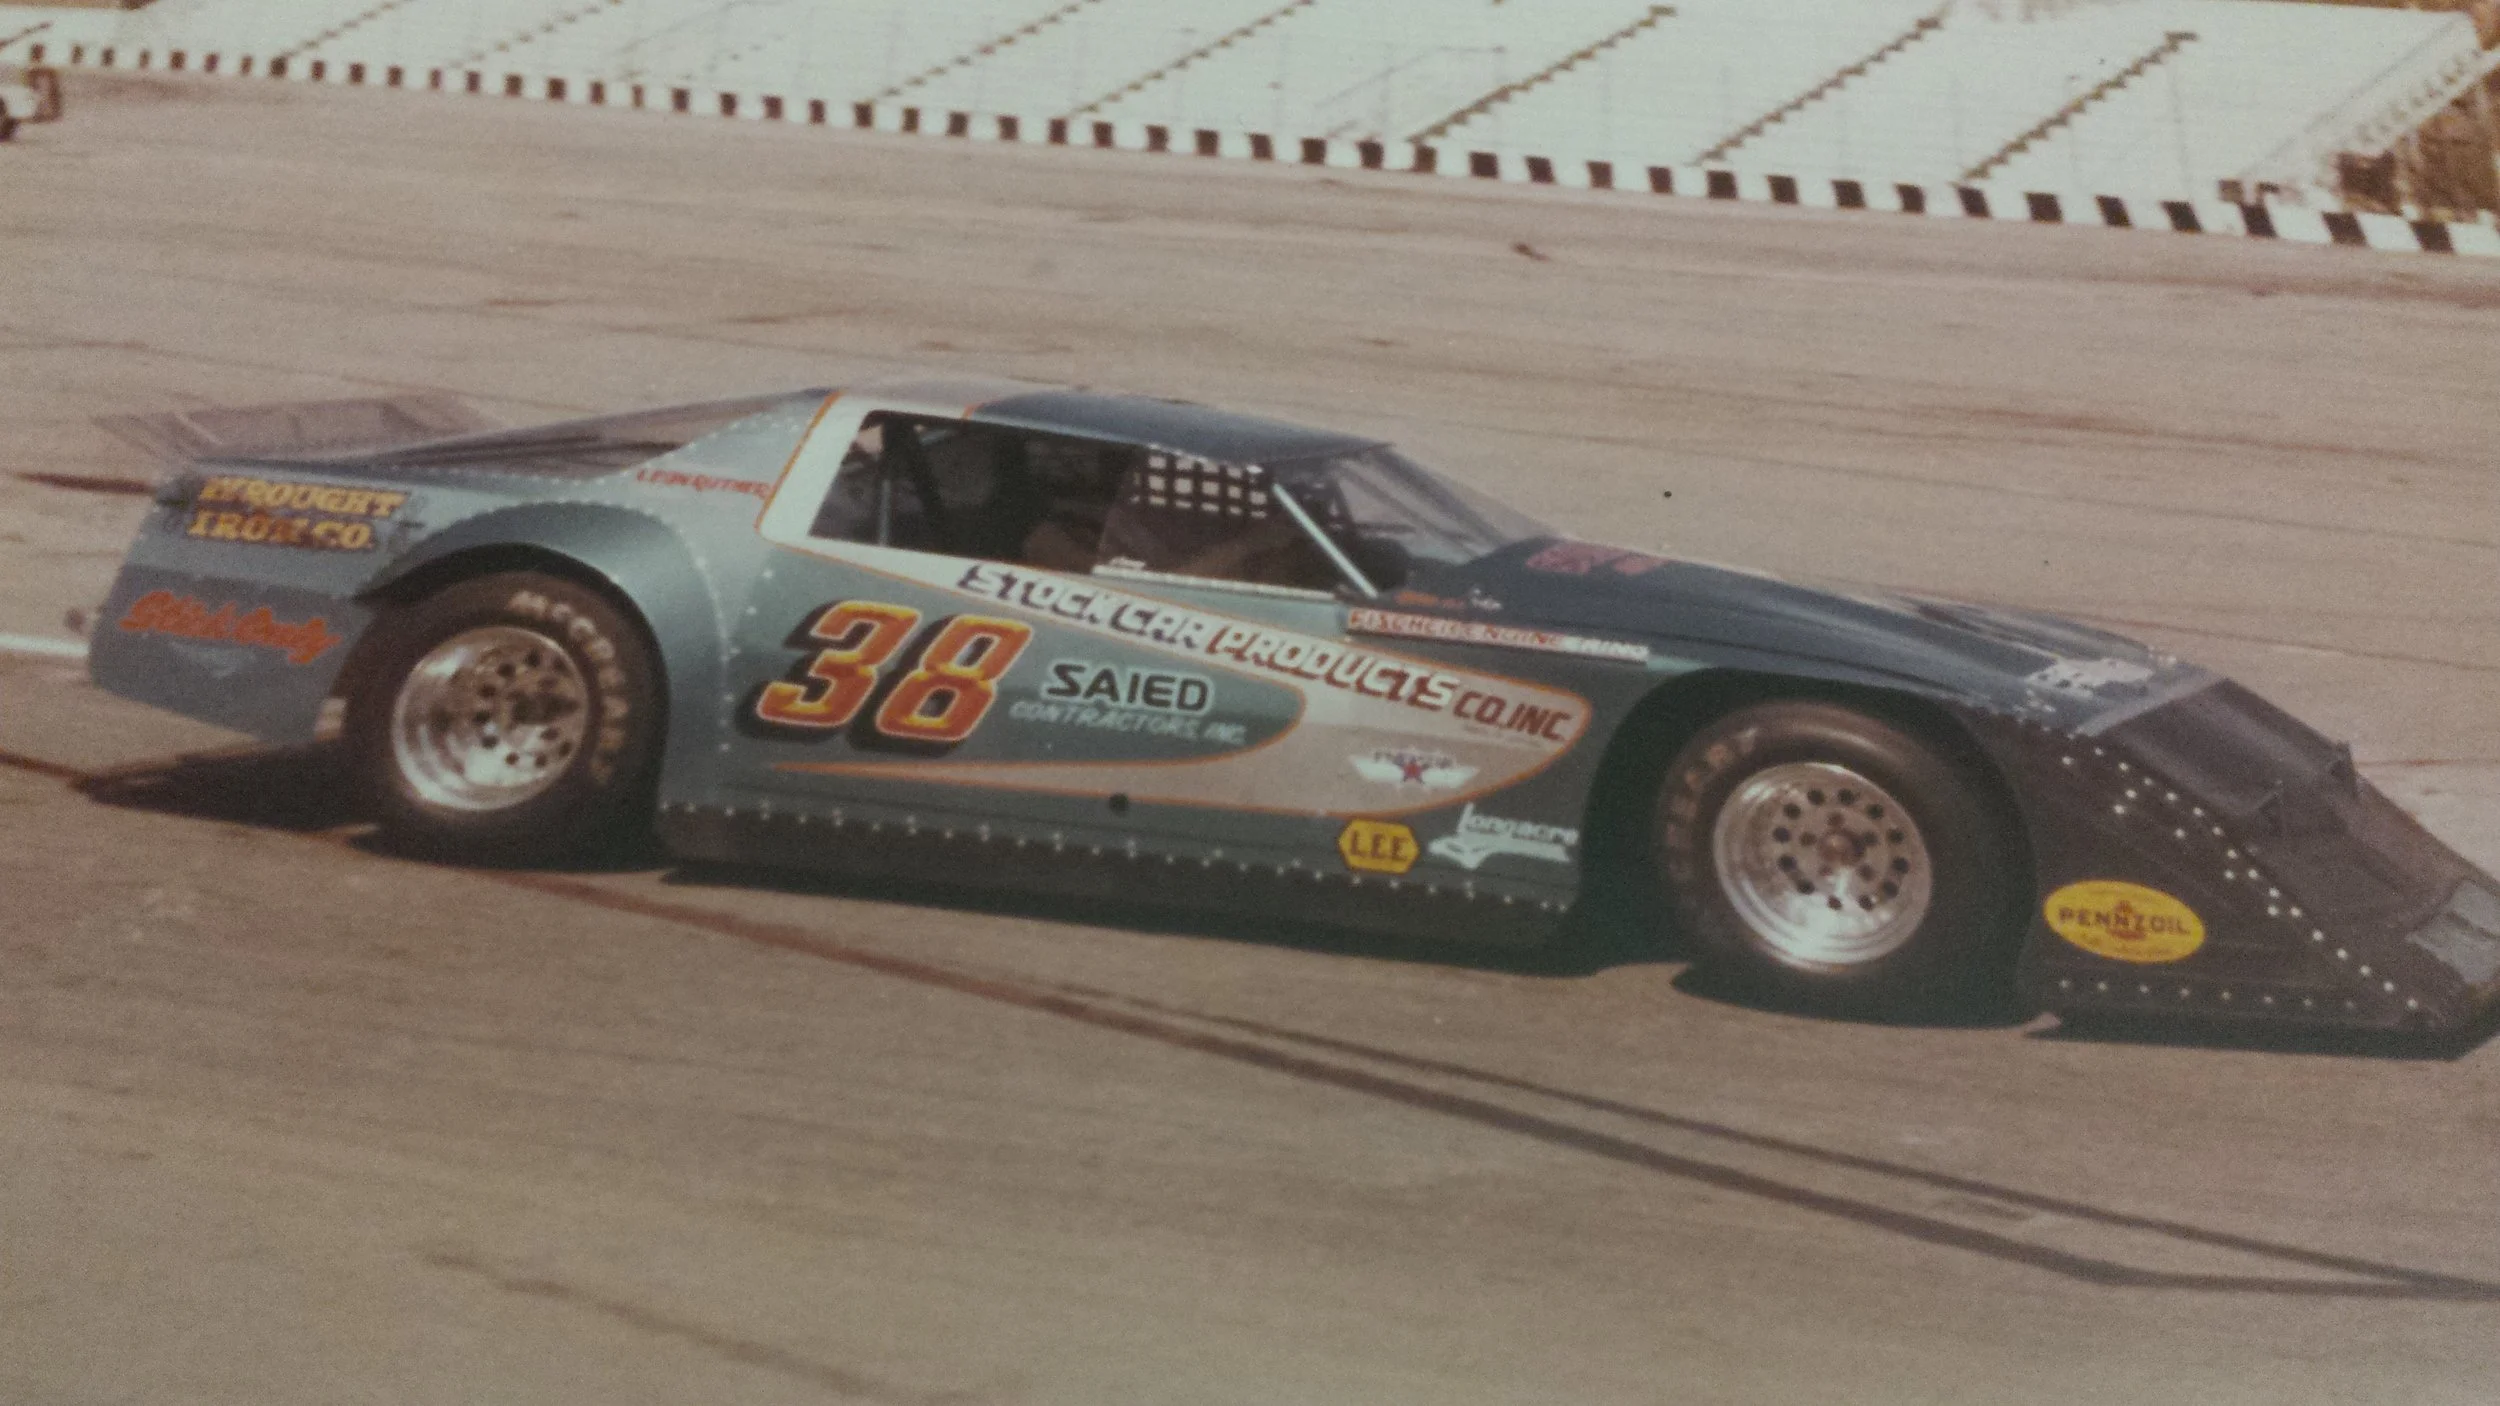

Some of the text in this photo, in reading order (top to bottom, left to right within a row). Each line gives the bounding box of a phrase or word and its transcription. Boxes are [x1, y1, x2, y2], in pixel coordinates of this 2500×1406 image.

[187, 509, 309, 544] IRON
[956, 564, 1107, 625] STOCK
[1109, 601, 1207, 650] CAR
[1204, 623, 1462, 711] PRODUCTS
[756, 599, 1033, 742] 38
[1046, 661, 1212, 714] SAIED
[1351, 829, 1409, 863] LEE
[2058, 905, 2191, 936] PENNZOIL
